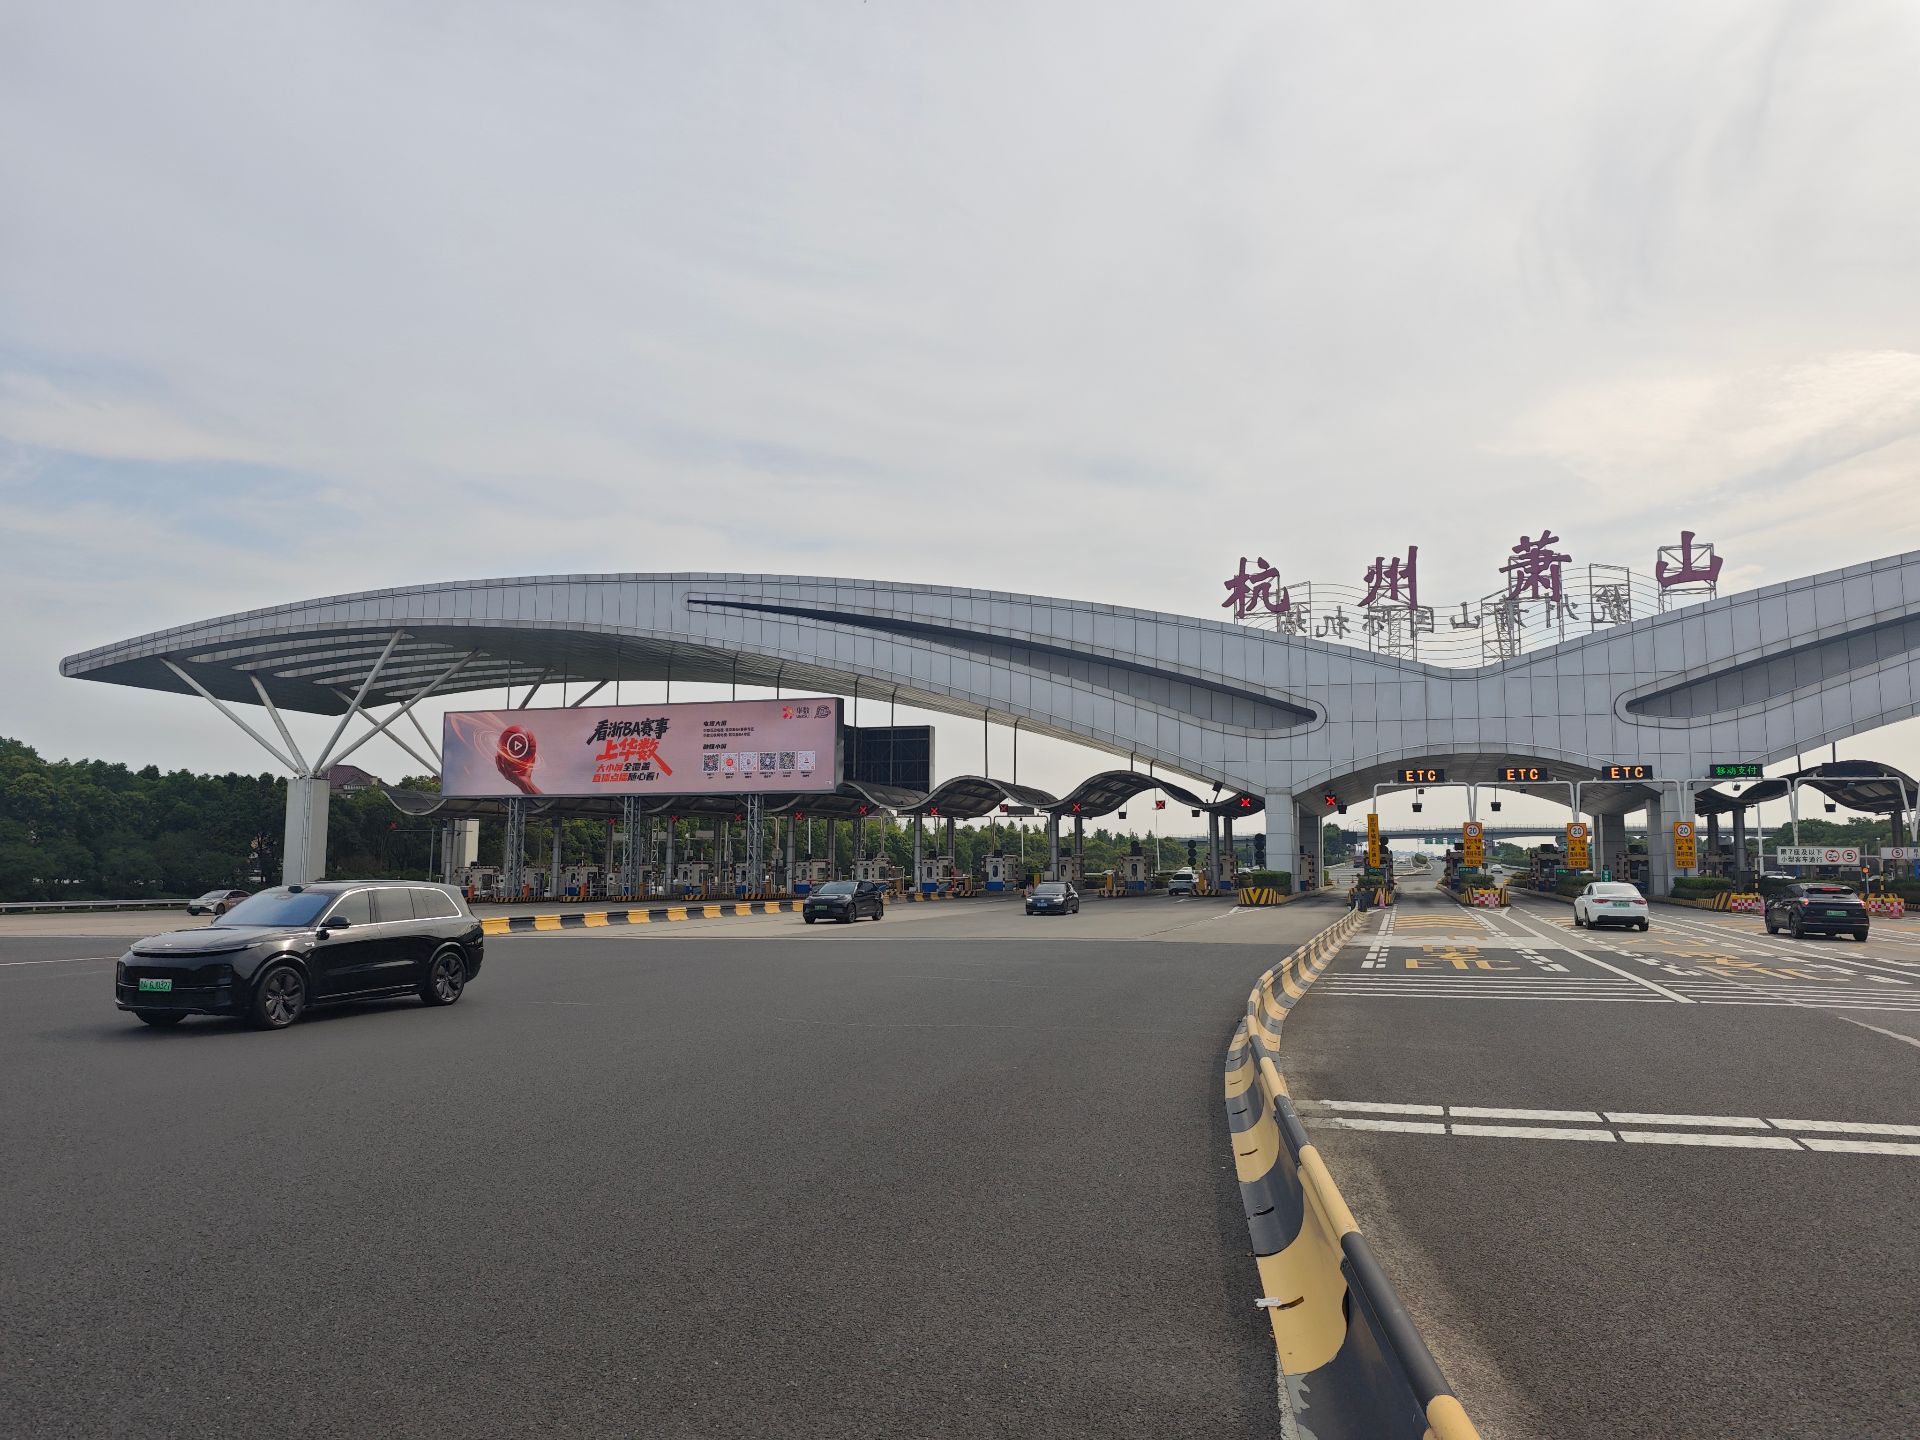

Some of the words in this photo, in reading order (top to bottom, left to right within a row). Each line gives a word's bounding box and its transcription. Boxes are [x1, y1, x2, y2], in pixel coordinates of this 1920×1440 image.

[1222, 530, 1723, 618] 杭州萧山
[586, 717, 671, 745] 看浙BA赛事
[596, 737, 672, 776] 上华数
[597, 762, 650, 772] 大小屏全覆盖
[1611, 767, 1643, 778] ETC
[1715, 766, 1757, 776] 移动支付
[1405, 770, 1436, 782] ETC
[1506, 769, 1539, 780] ETC
[1781, 856, 1823, 864] 小型客车通行
[1406, 958, 1521, 970] ETC
